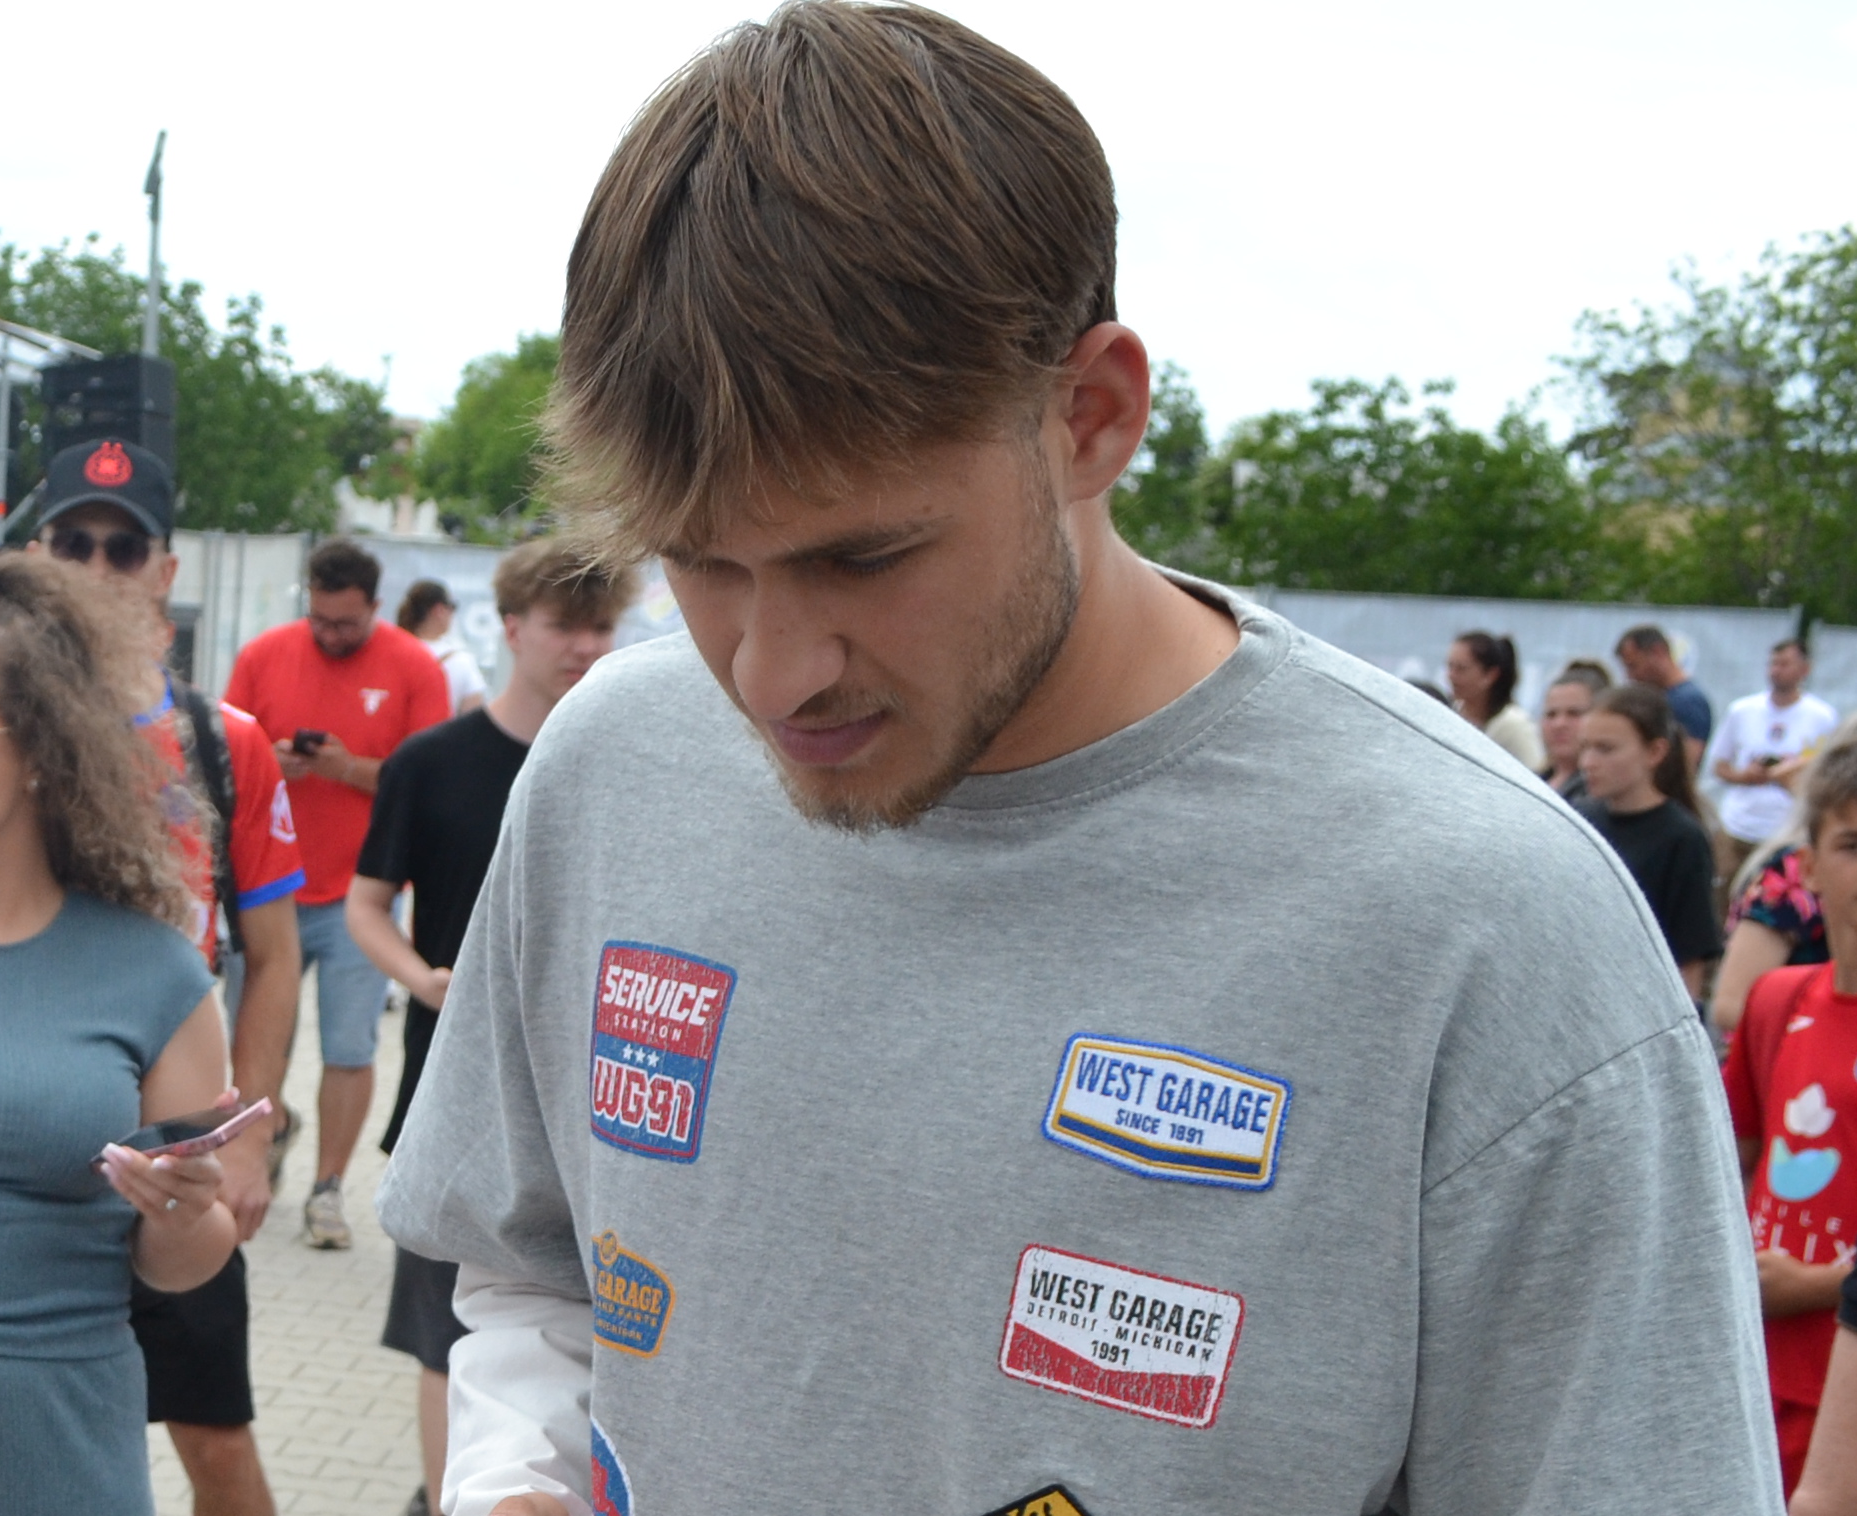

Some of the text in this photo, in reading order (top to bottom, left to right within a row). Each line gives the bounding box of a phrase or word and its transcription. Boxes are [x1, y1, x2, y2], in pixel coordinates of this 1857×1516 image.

[602, 964, 718, 1026] SERVICE
[614, 1012, 682, 1041] STATION
[593, 1055, 695, 1143] WG91
[1075, 1050, 1272, 1135] WEST GARAGE
[1114, 1108, 1161, 1136] SINCE
[597, 1269, 662, 1315] GARAGE
[1029, 1268, 1223, 1344] WEST GARAGE
[1026, 1301, 1098, 1332] DETROIT
[1115, 1325, 1213, 1362] MICHIGAN
[1091, 1340, 1130, 1366] 1991
